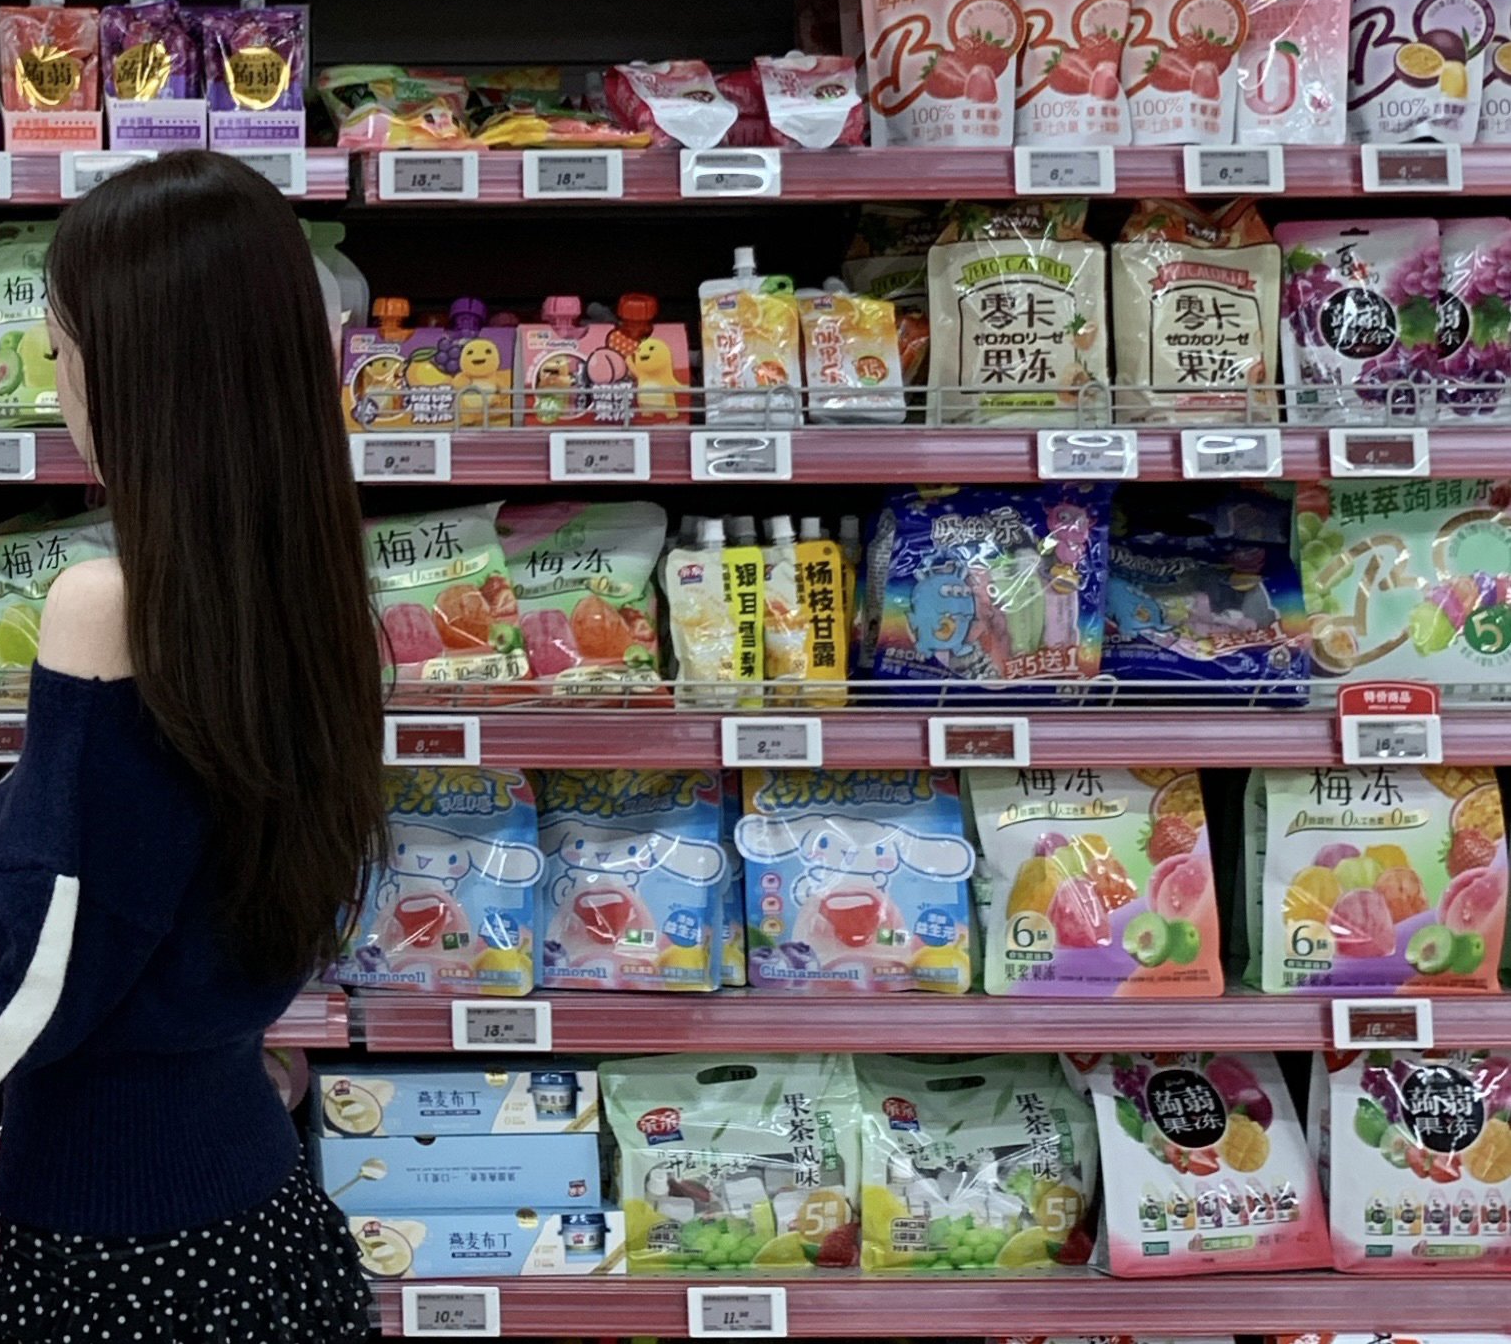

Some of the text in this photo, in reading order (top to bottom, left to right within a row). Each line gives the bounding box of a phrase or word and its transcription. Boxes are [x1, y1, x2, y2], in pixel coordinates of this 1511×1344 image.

[981, 292, 1055, 329] 零卡
[1176, 295, 1241, 332] 零卡
[981, 348, 1057, 384] 果冻
[1, 535, 70, 580] 梅冻
[373, 521, 464, 570] 梅冻
[526, 547, 614, 579] 梅冻
[805, 561, 836, 668] 杨枝甘露
[1309, 766, 1405, 807] 梅冻
[417, 1089, 482, 1109] 燕麦布丁
[1153, 1086, 1217, 1118] 蒟蒻
[448, 1231, 513, 1252] 燕麦布丁
